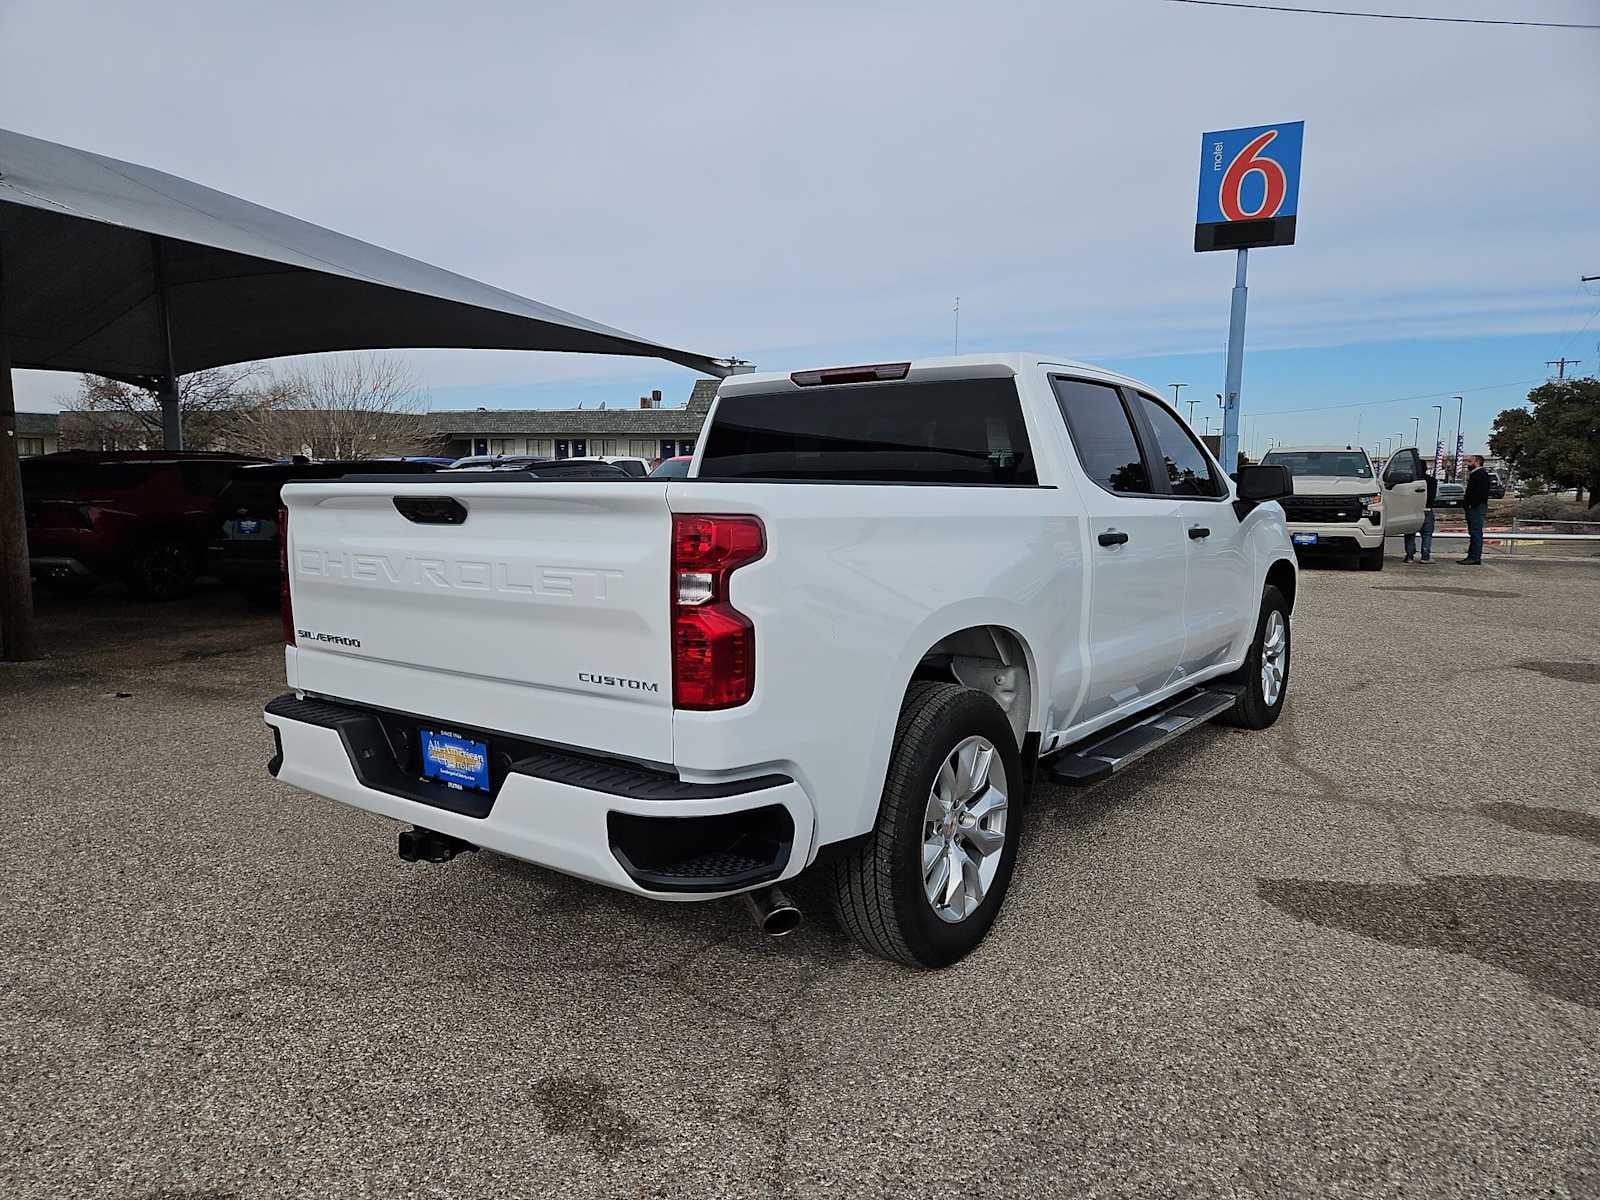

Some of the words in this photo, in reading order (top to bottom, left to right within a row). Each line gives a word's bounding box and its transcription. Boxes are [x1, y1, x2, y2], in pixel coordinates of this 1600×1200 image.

[1213, 141, 1224, 171] motel
[1218, 129, 1287, 221] 6
[297, 549, 624, 600] CHEVROLET
[297, 629, 361, 648] SILVERADO
[578, 672, 658, 693] CUSTOM
